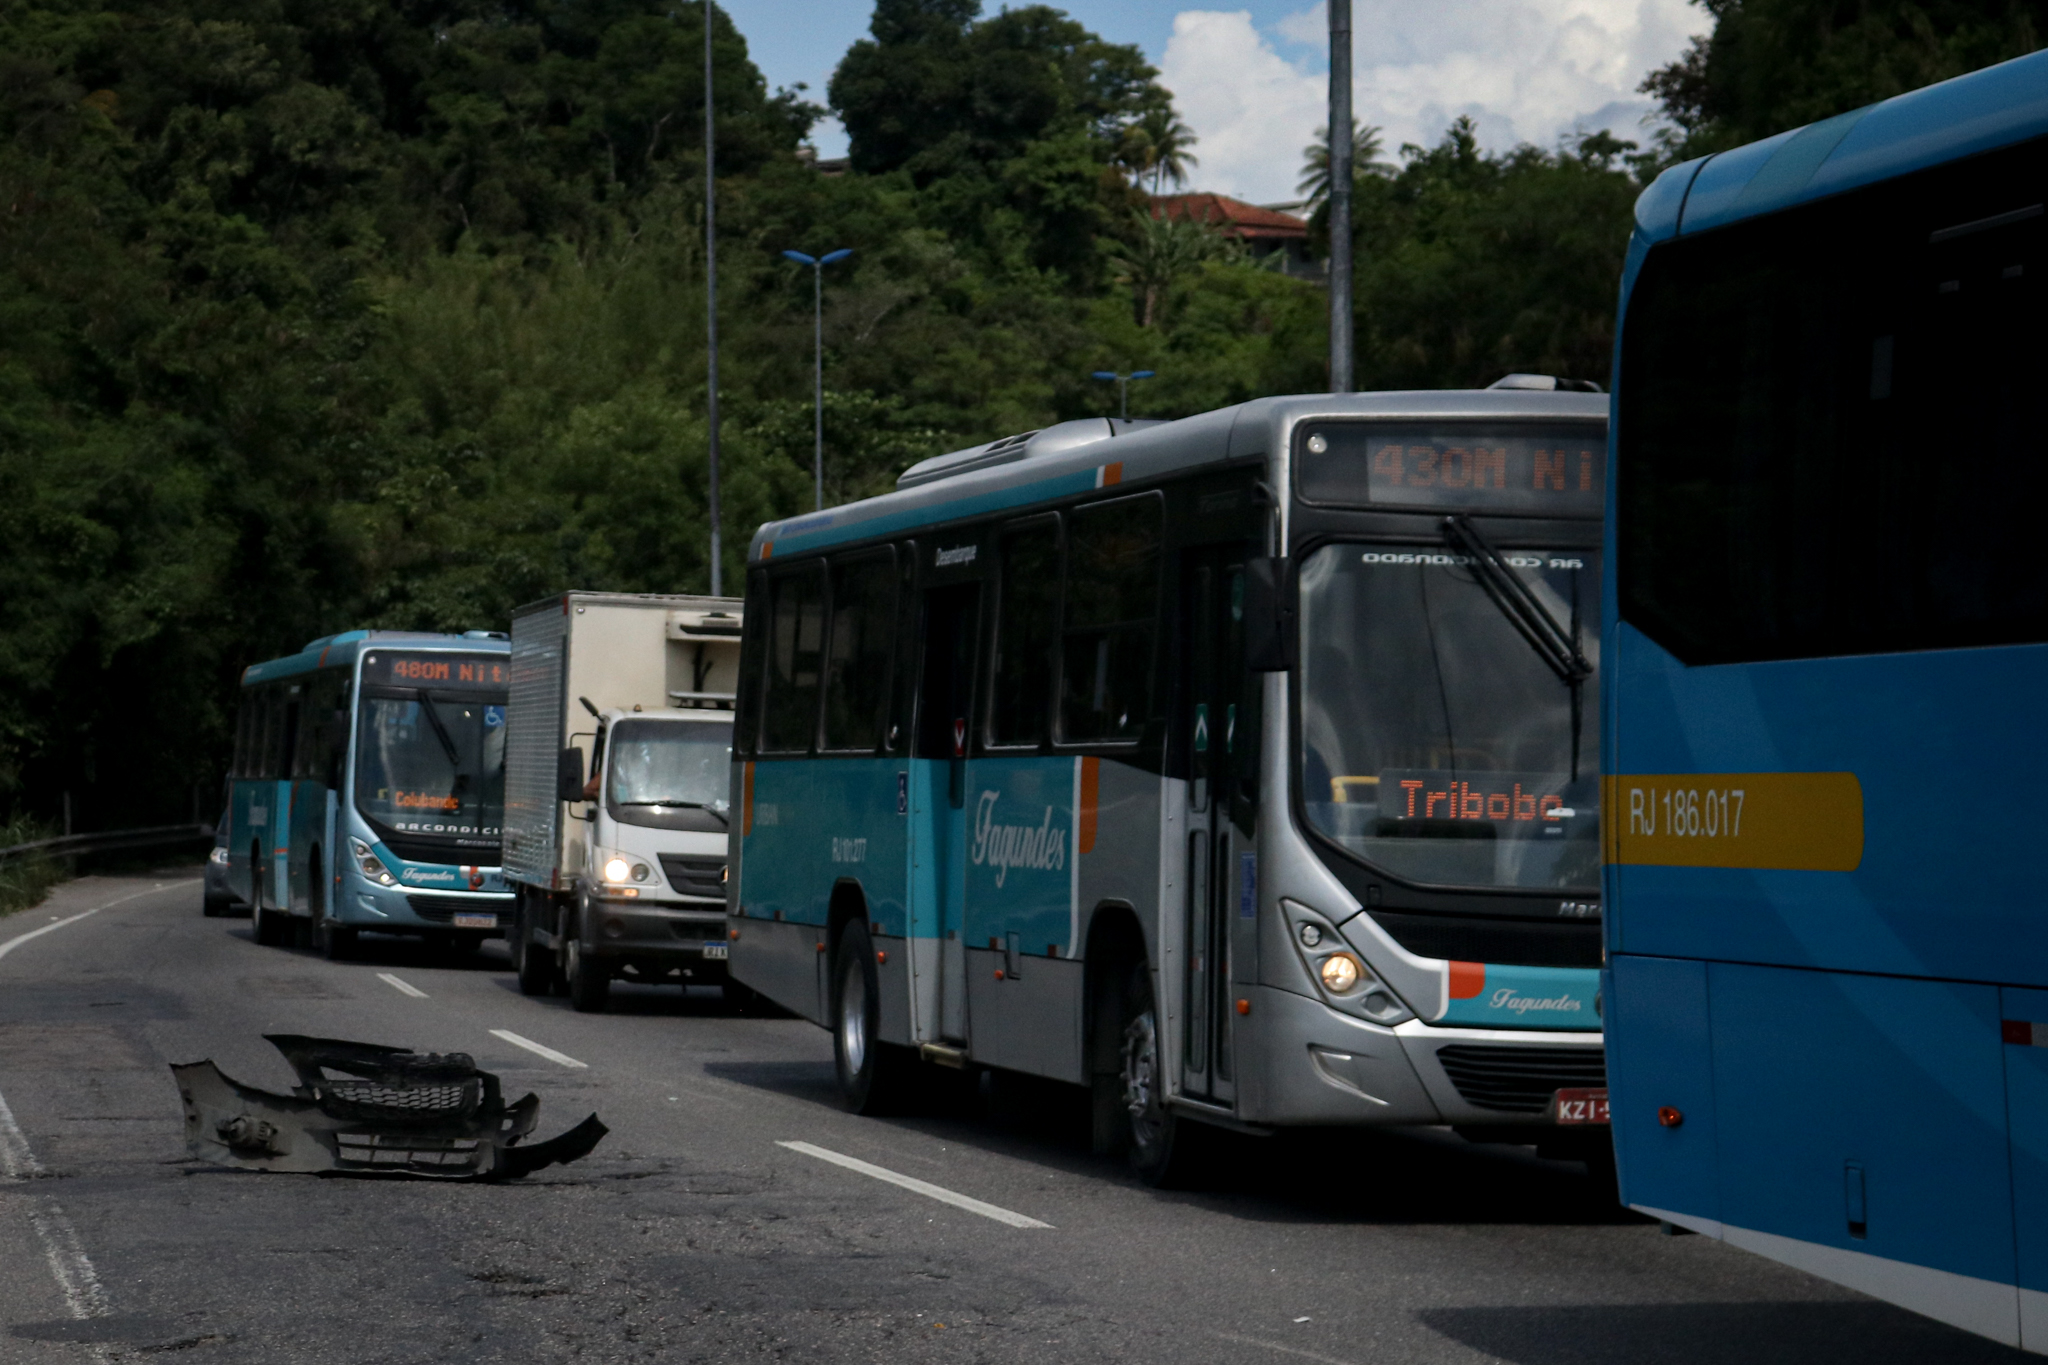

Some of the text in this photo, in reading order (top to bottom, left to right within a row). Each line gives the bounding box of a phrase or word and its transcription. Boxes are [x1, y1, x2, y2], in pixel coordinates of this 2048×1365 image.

[1374, 445, 1592, 491] 430M Ni
[395, 660, 450, 681] 480M
[1400, 779, 1563, 821] Tribobo
[1630, 788, 1746, 837] RJ 186.017
[972, 789, 1066, 889] Fagundes
[401, 866, 456, 883] Fagundes
[1489, 988, 1582, 1015] Fagundes
